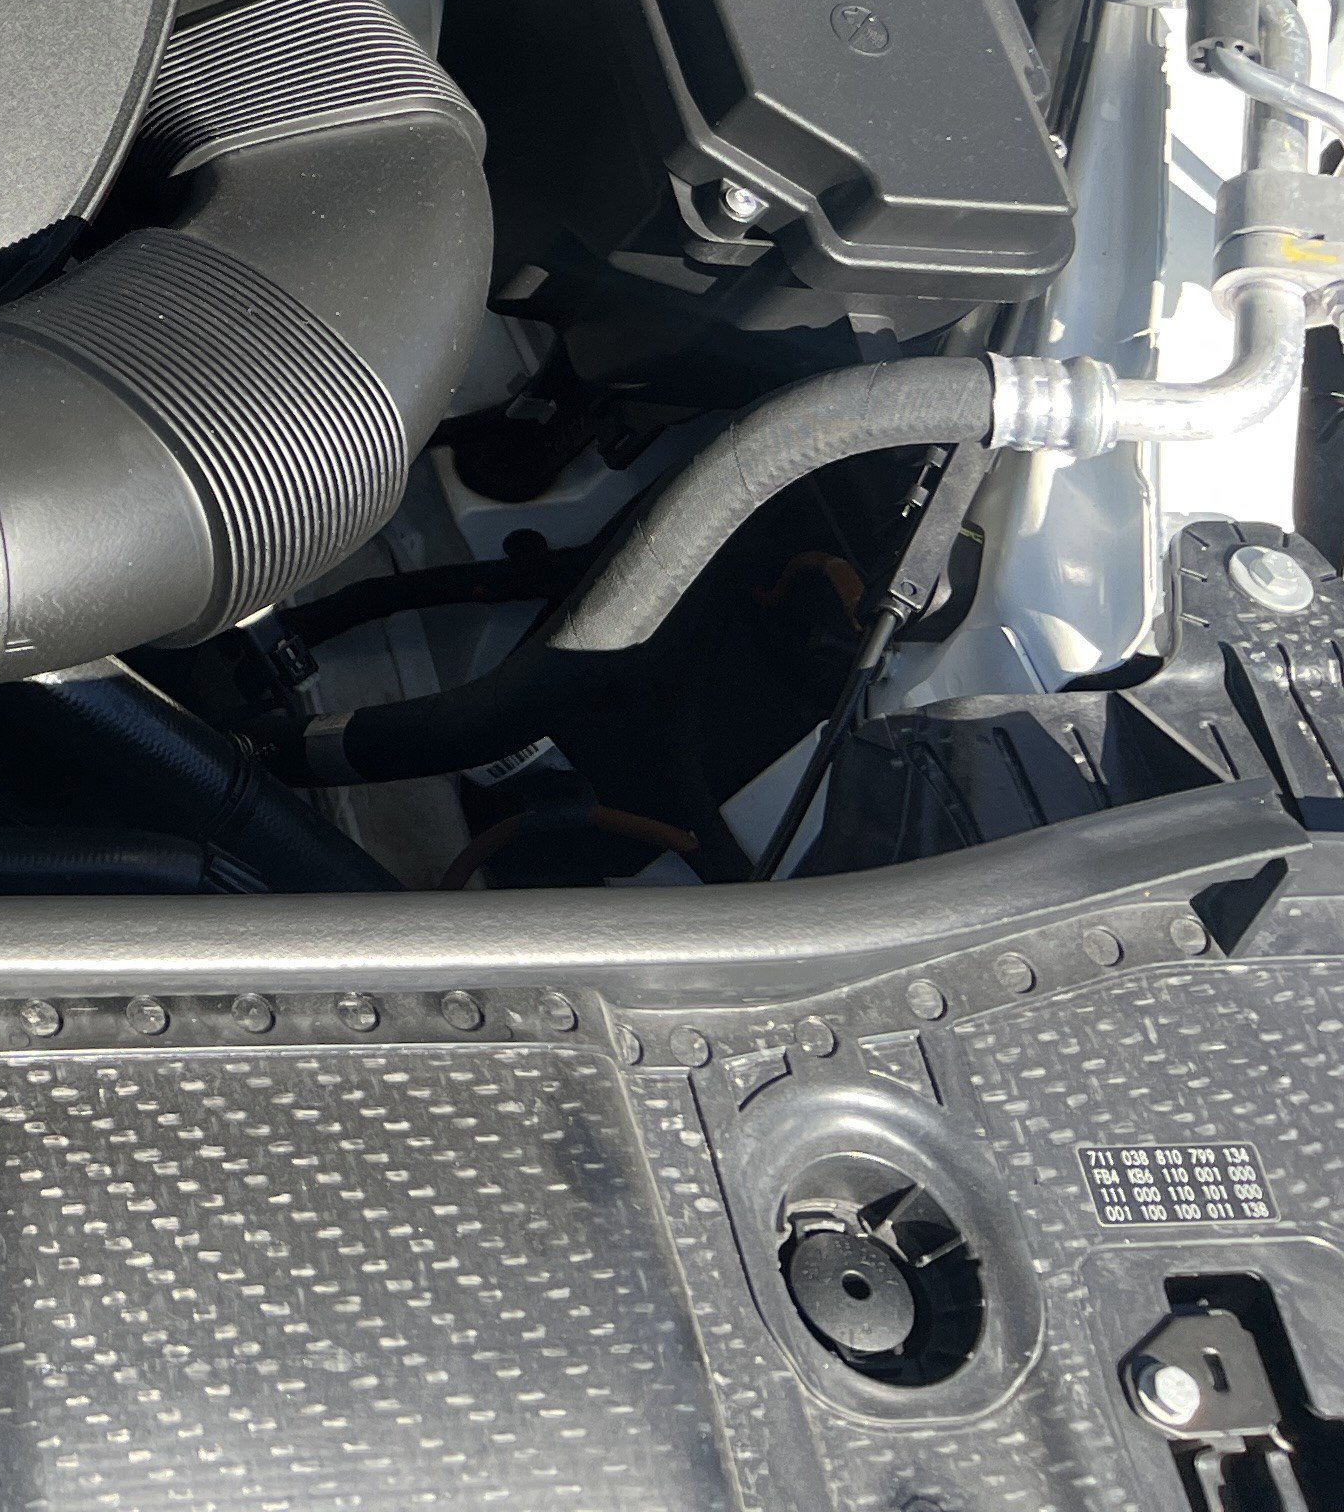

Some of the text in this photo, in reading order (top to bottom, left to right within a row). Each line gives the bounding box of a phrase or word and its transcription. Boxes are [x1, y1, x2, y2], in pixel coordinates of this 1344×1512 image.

[1087, 1148, 1250, 1166] 711 038 810 799 134
[1092, 1169, 1120, 1185] FB4
[1162, 1167, 1189, 1184] 110
[1194, 1166, 1222, 1182] 001
[1228, 1166, 1256, 1182] 000
[1100, 1184, 1263, 1203] 111 000 110 101 000
[1104, 1205, 1133, 1222] 001
[1140, 1205, 1168, 1221] 100
[1174, 1204, 1202, 1220] 100
[1206, 1203, 1235, 1219] 011
